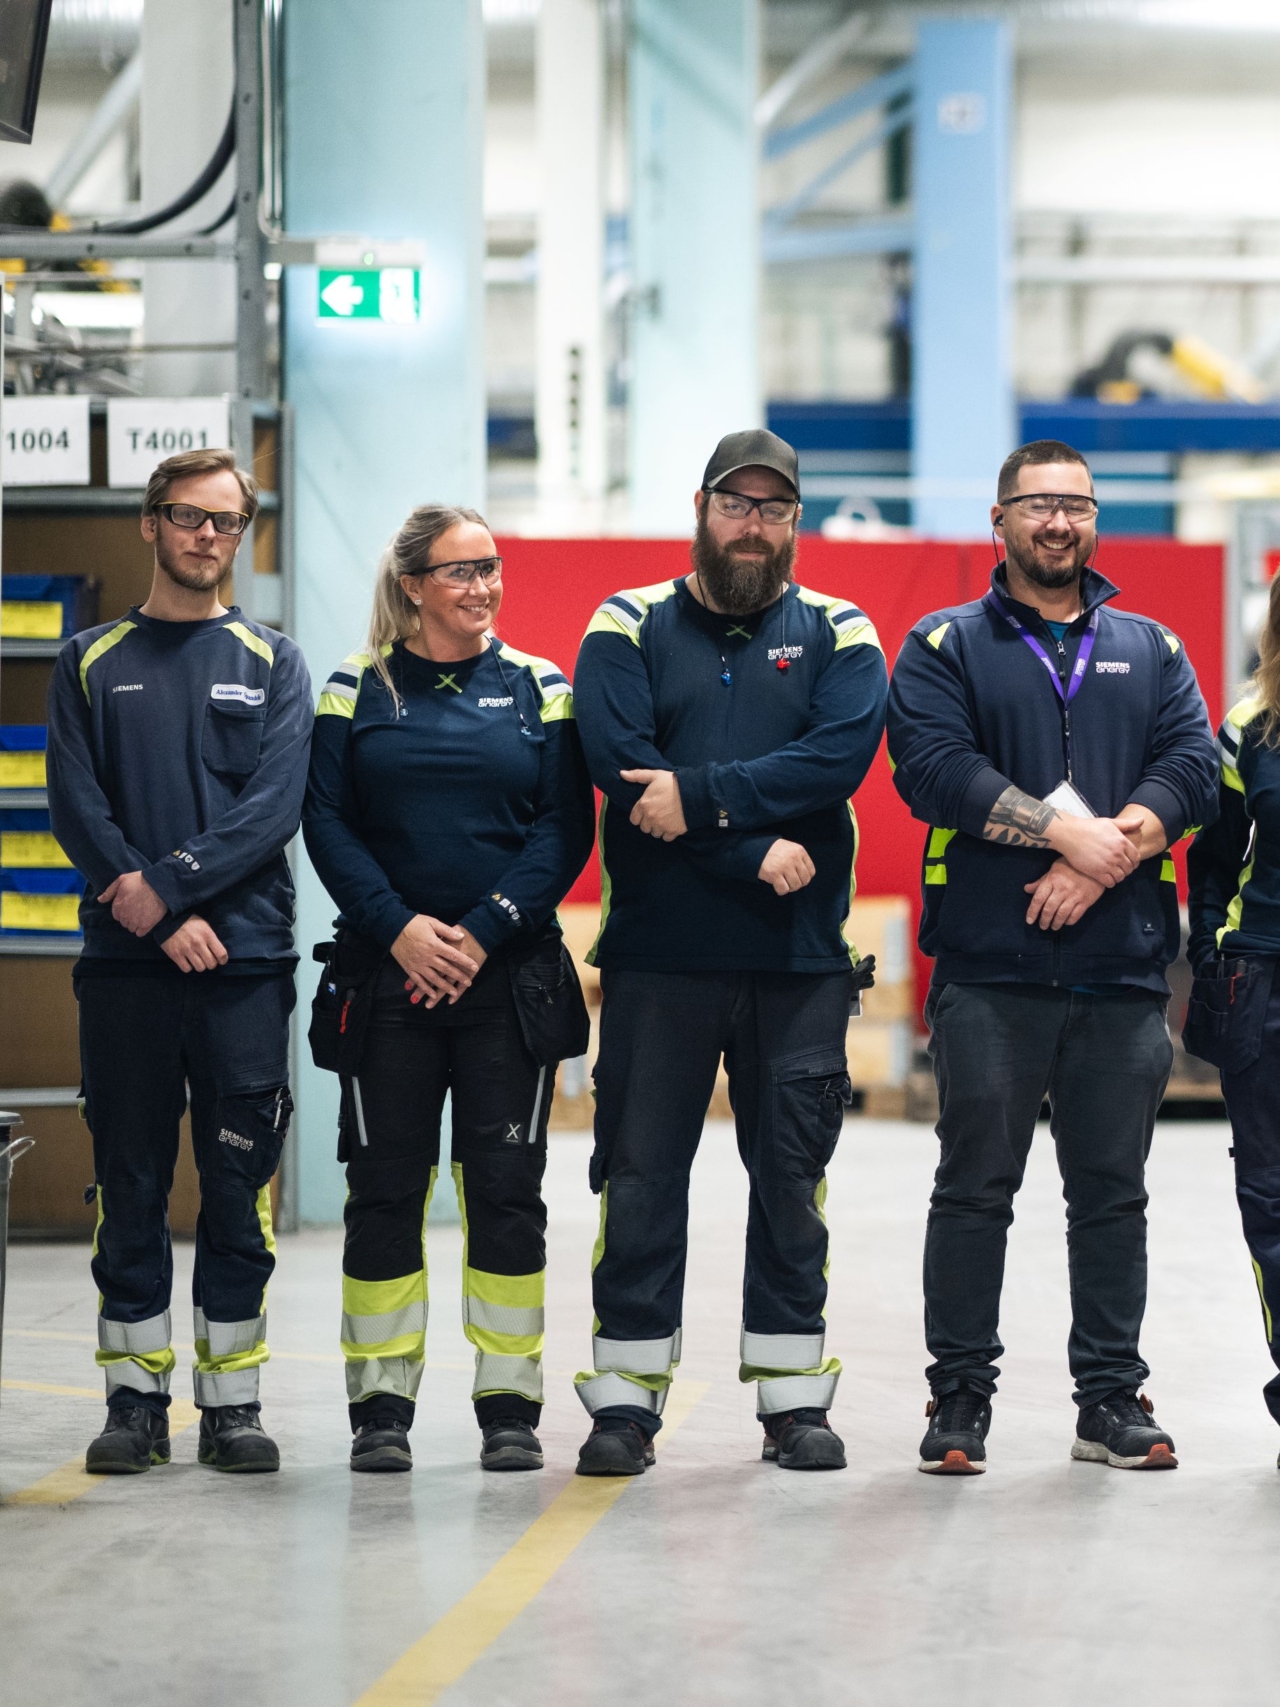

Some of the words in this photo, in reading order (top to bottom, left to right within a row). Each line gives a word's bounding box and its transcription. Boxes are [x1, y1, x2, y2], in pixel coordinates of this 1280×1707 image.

[126, 427, 208, 452] T4001
[112, 683, 143, 694] SIEMENS
[220, 1128, 254, 1147] SIEMENS
